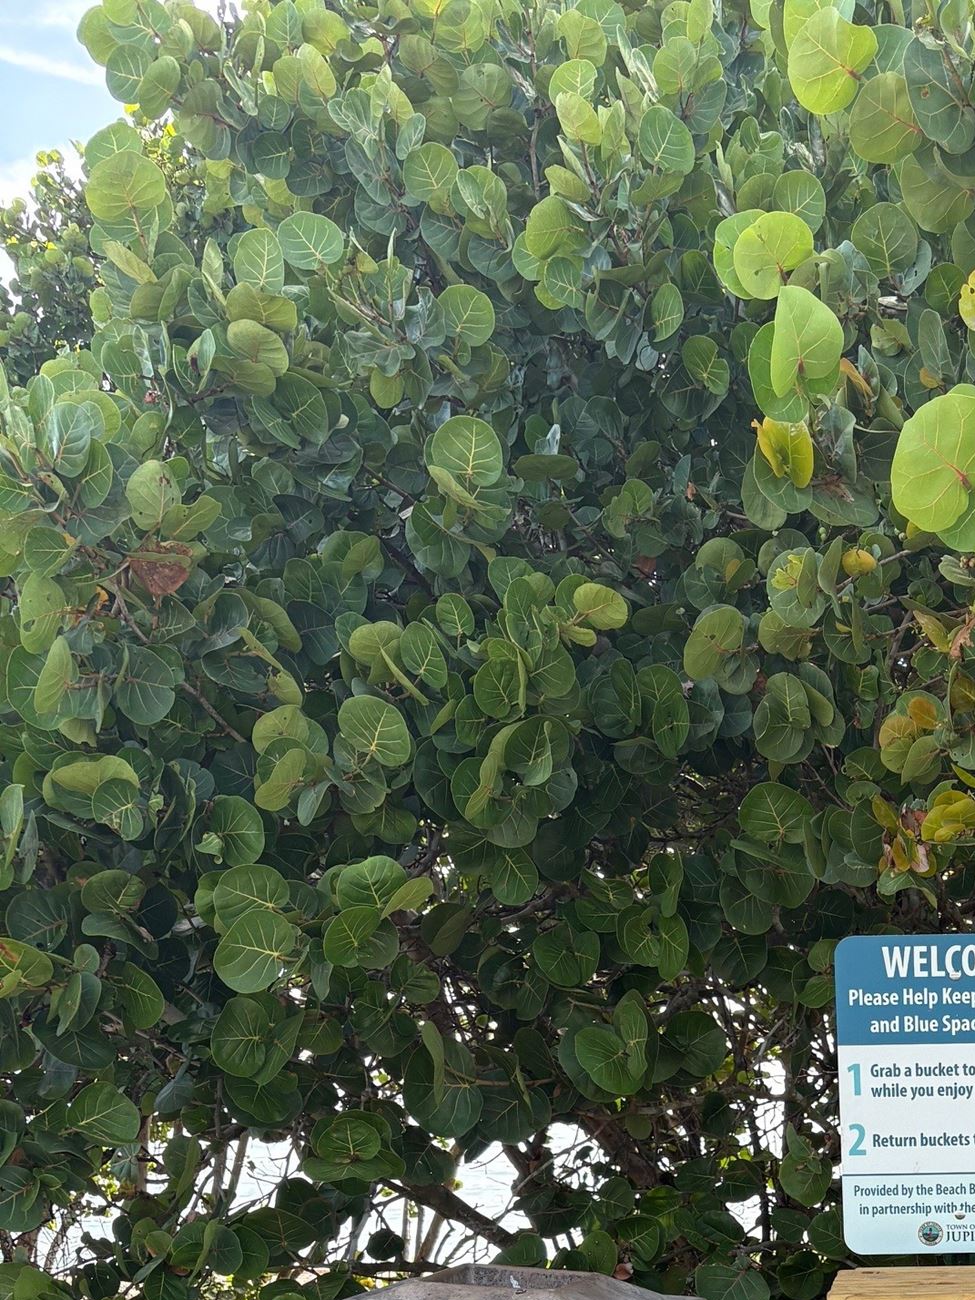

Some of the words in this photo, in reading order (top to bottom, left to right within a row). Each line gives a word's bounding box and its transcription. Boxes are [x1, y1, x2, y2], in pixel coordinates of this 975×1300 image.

[848, 989, 899, 1006] Please
[903, 988, 938, 1009] Help
[870, 1016, 900, 1033] and
[904, 1015, 939, 1032] Blue
[870, 1063, 901, 1078] Grab
[904, 1066, 912, 1077] a
[915, 1062, 959, 1077] bucket
[847, 1063, 862, 1096] 1
[871, 1083, 908, 1098] while
[910, 1085, 935, 1100] you
[937, 1083, 975, 1099] enjoy
[848, 1123, 867, 1156] 2
[872, 1133, 917, 1148] Return
[920, 1132, 970, 1147] buckets
[854, 1184, 899, 1197] Provided
[901, 1184, 914, 1199] by
[916, 1183, 933, 1196] the
[936, 1182, 967, 1196] Beach
[860, 1203, 869, 1215] in
[872, 1202, 932, 1218] partnership
[934, 1202, 958, 1215] with
